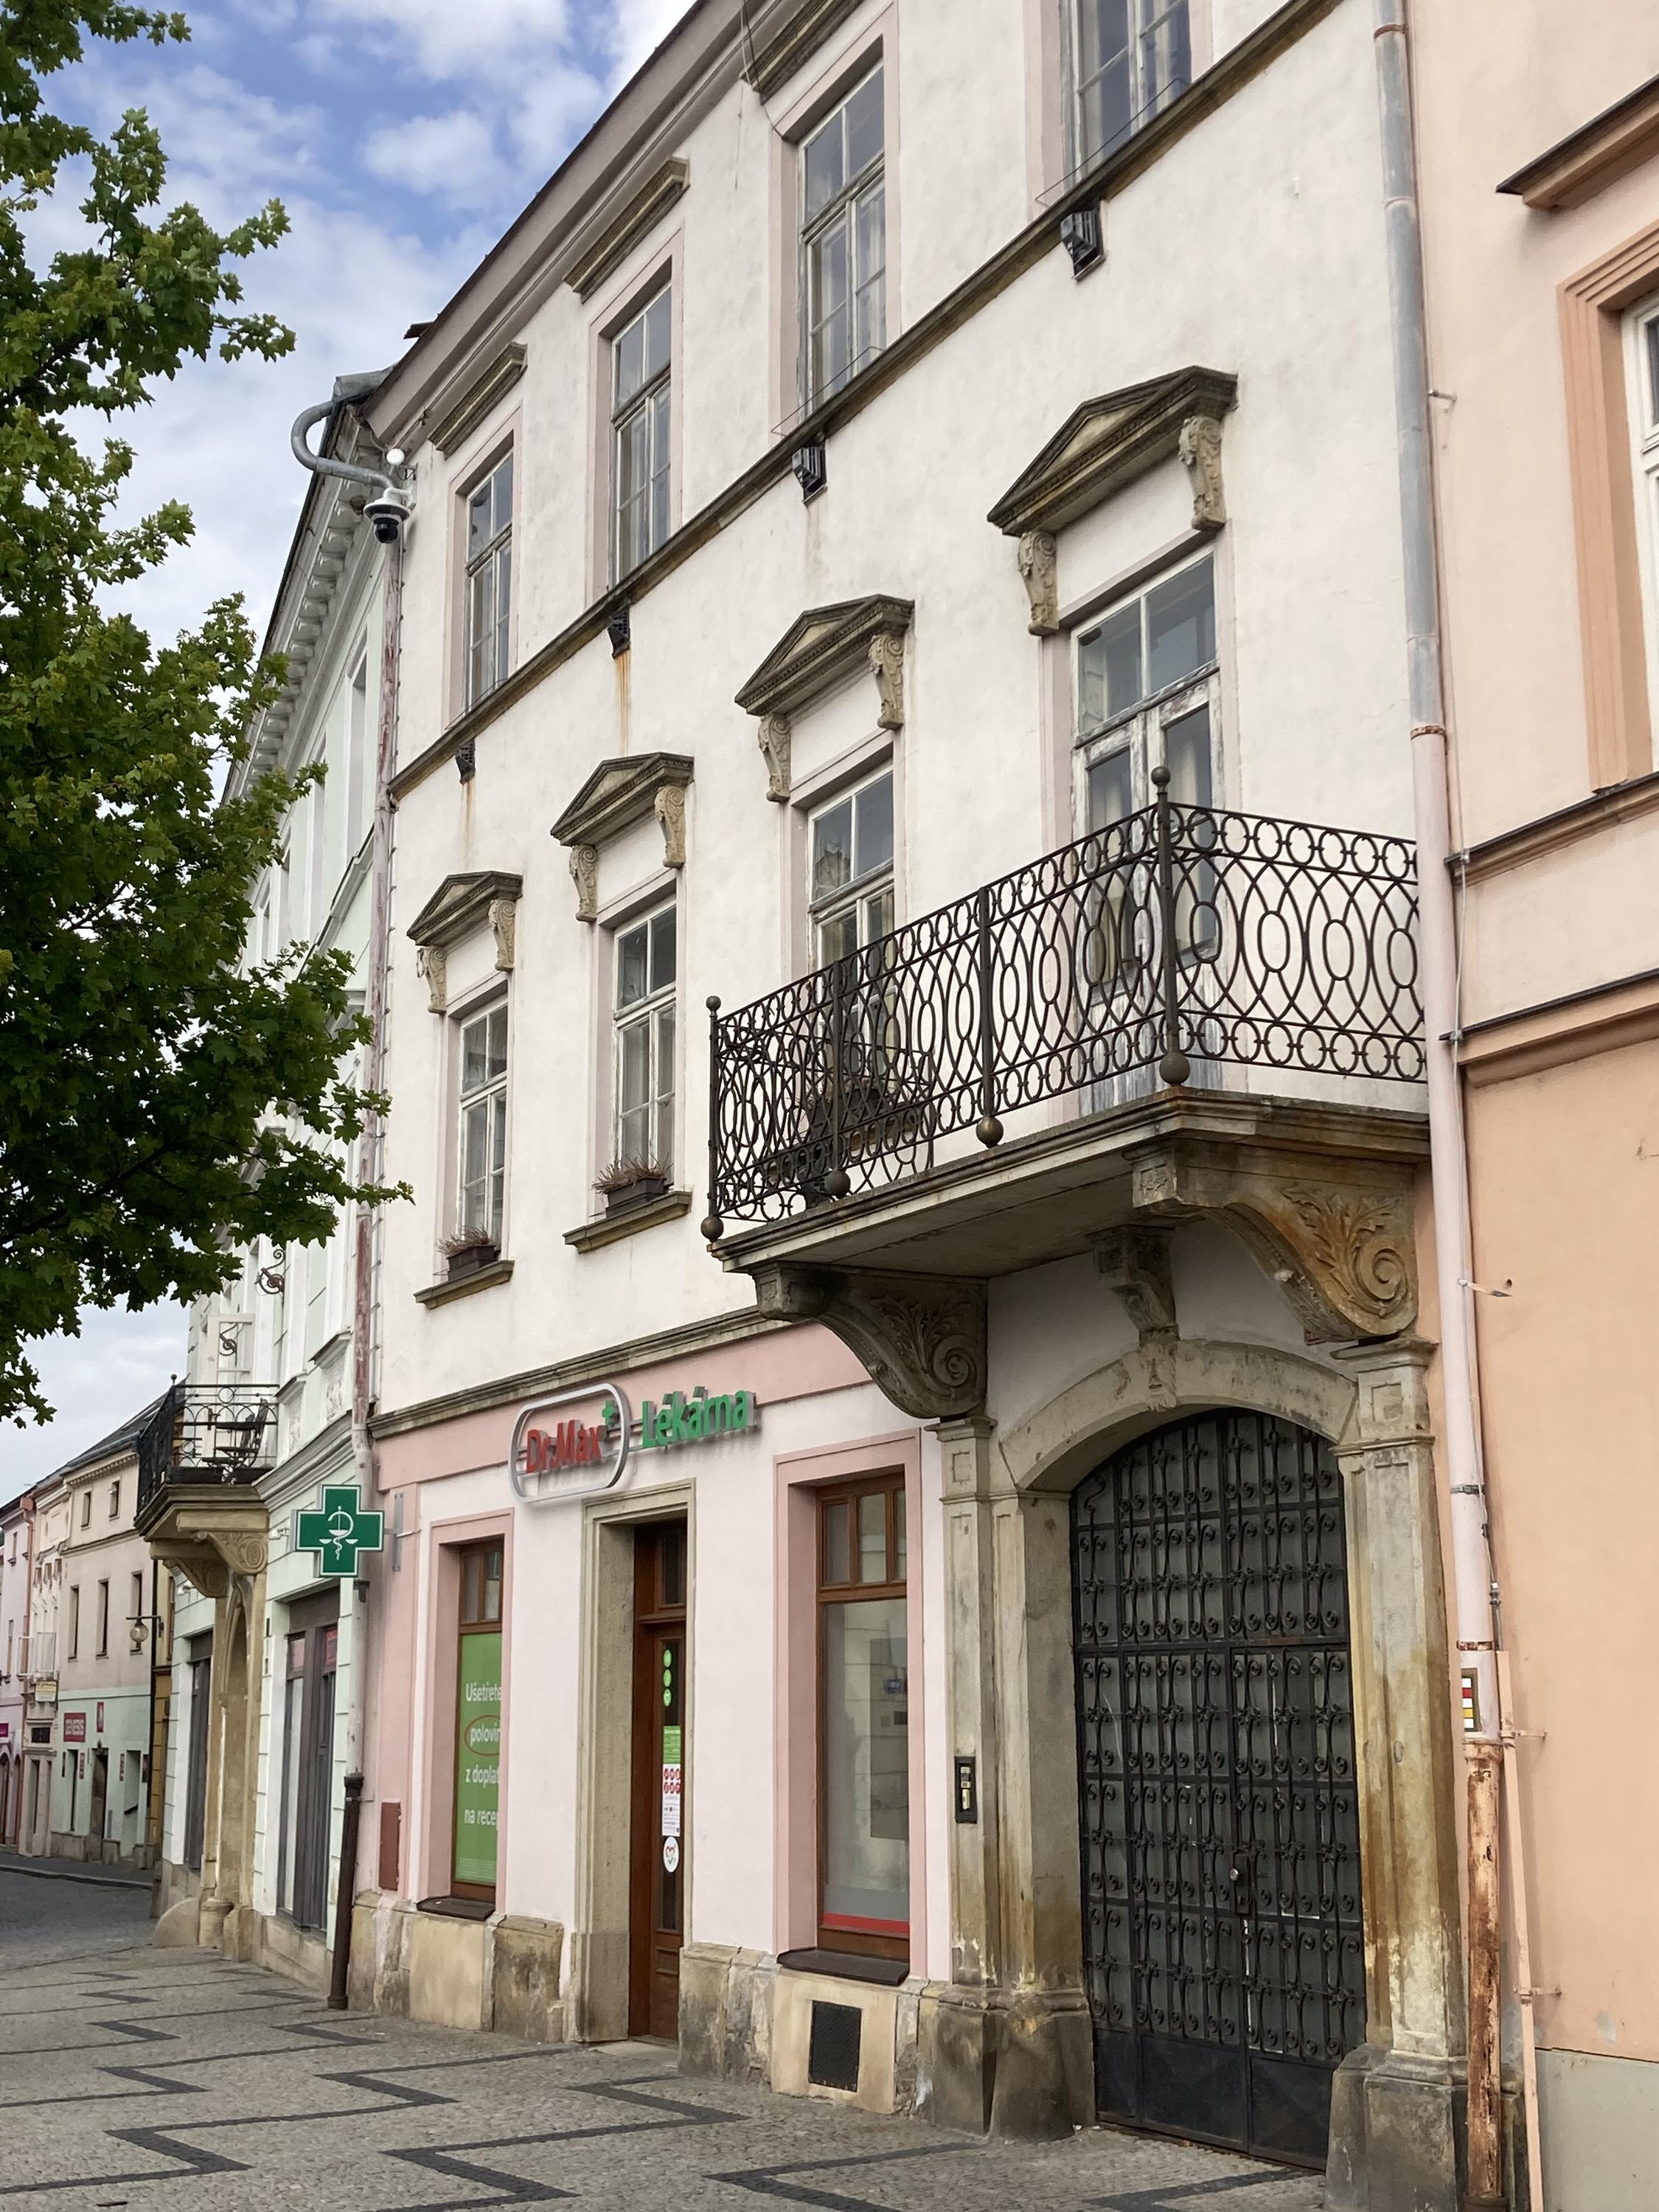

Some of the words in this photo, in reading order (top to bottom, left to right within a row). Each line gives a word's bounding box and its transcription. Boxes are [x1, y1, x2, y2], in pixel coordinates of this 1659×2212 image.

[642, 1386, 750, 1449] Lékárna
[465, 1768, 471, 1783] z
[464, 1809, 476, 1824] na
